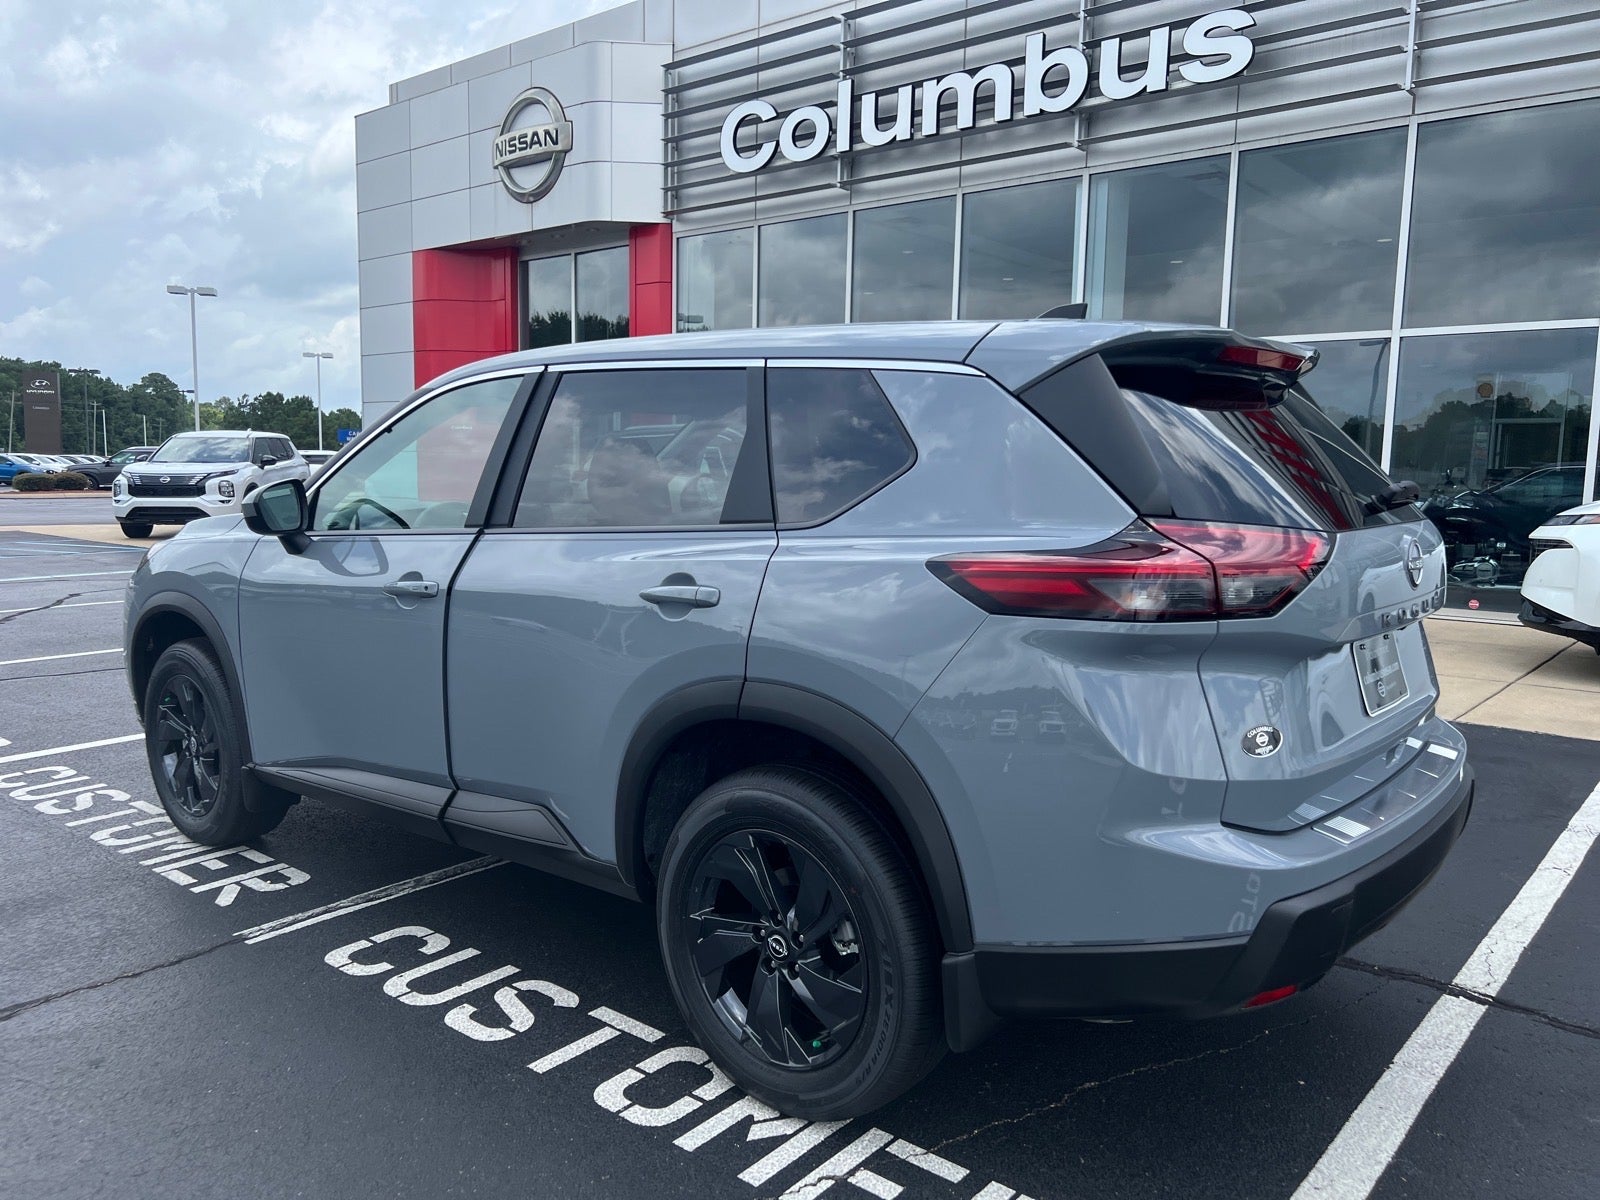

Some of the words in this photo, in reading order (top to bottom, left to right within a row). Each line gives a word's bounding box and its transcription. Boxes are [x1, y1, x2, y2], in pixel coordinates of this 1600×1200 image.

[719, 9, 1257, 174] Columbus
[494, 127, 559, 160] NISSAN
[1380, 591, 1440, 629] ROGUE
[1247, 726, 1273, 738] COLUMBUS
[0, 765, 311, 908] CUSTOMER
[324, 925, 1036, 1200] CUSTOME
